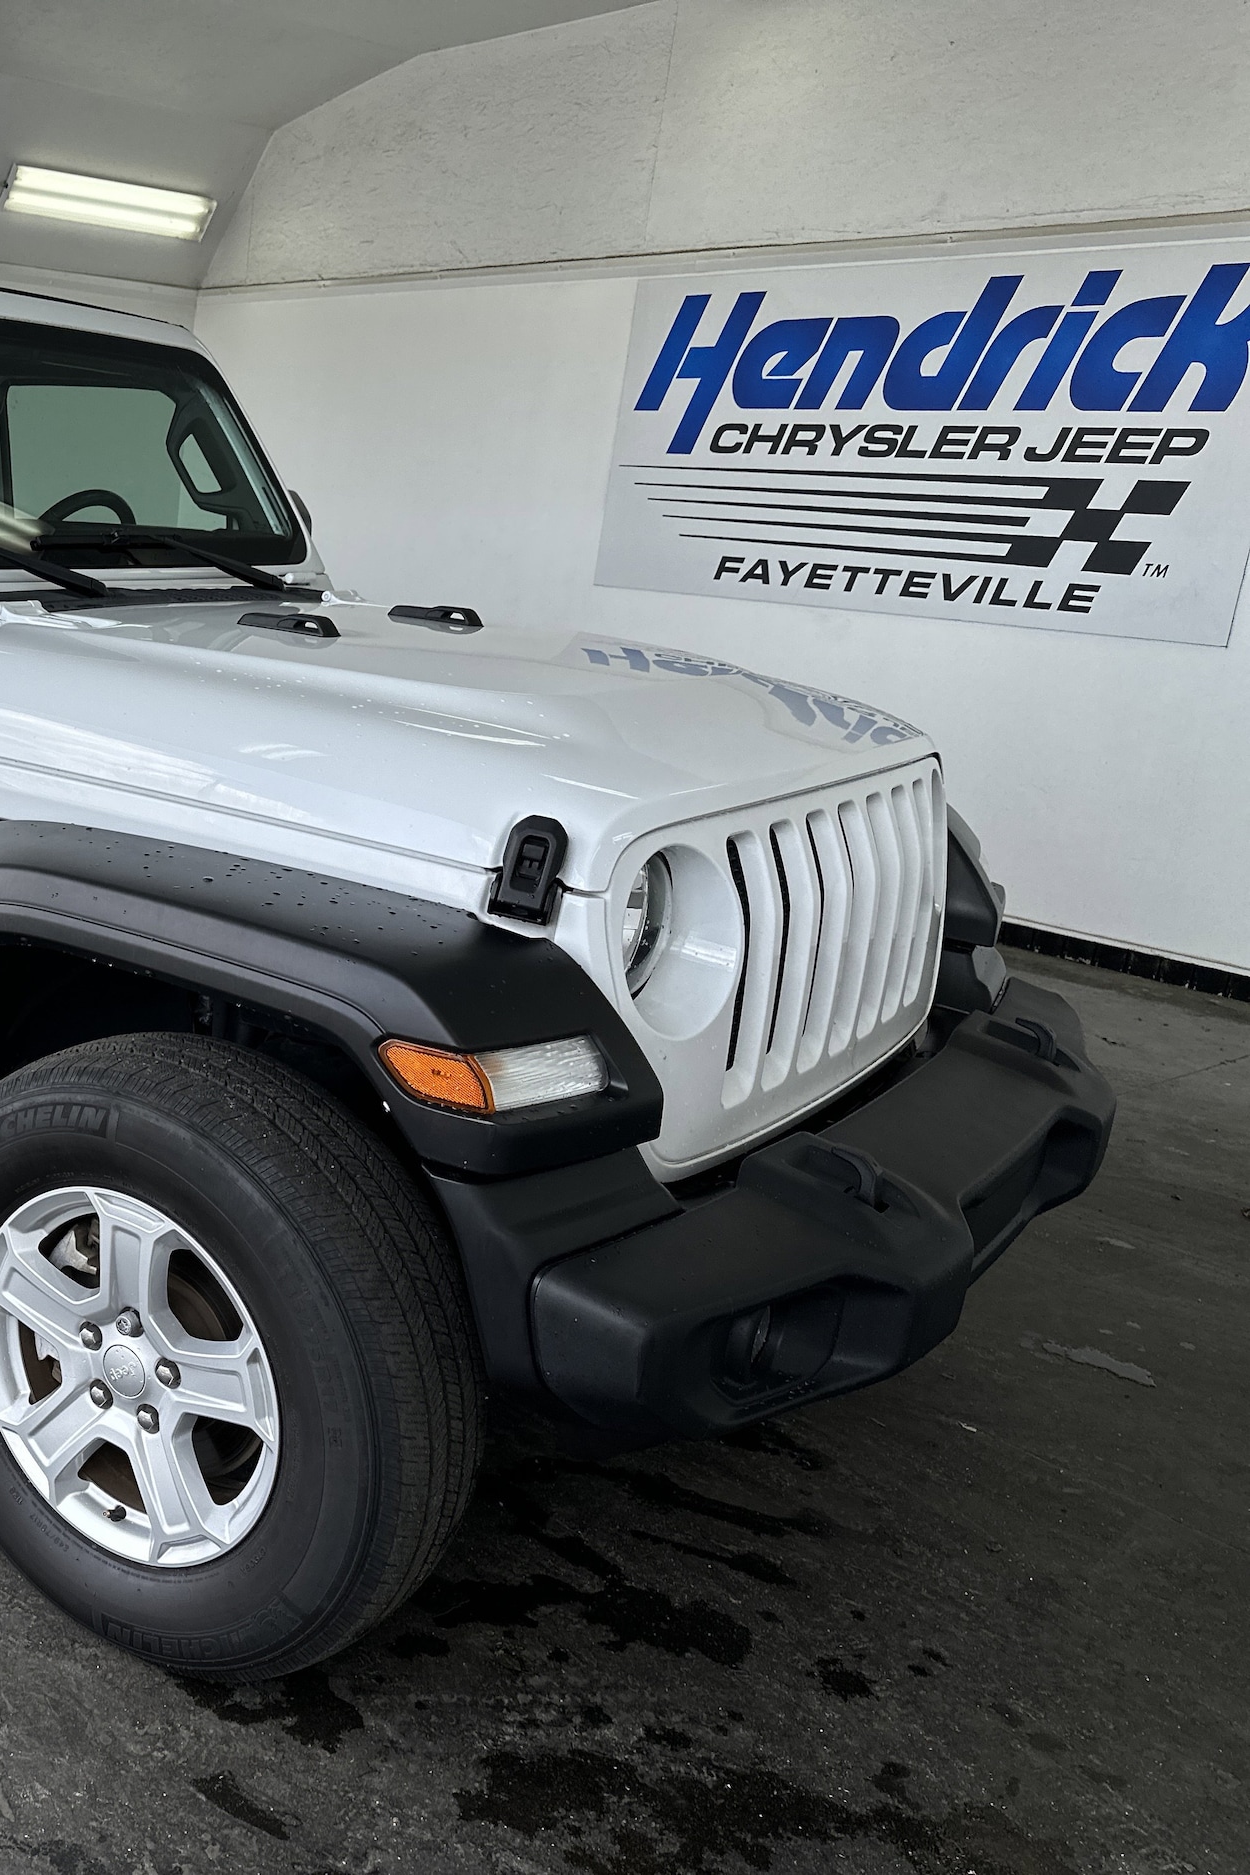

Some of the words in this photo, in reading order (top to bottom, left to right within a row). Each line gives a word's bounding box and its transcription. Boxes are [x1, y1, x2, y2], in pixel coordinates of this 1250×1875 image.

[634, 263, 1250, 454] Hendrick
[709, 422, 1025, 461] CHRYSLER
[1023, 427, 1210, 464] JEEP
[713, 556, 1101, 613] FAYETTEVILLE
[1143, 563, 1170, 579] TM
[110, 1361, 138, 1380] Jeep
